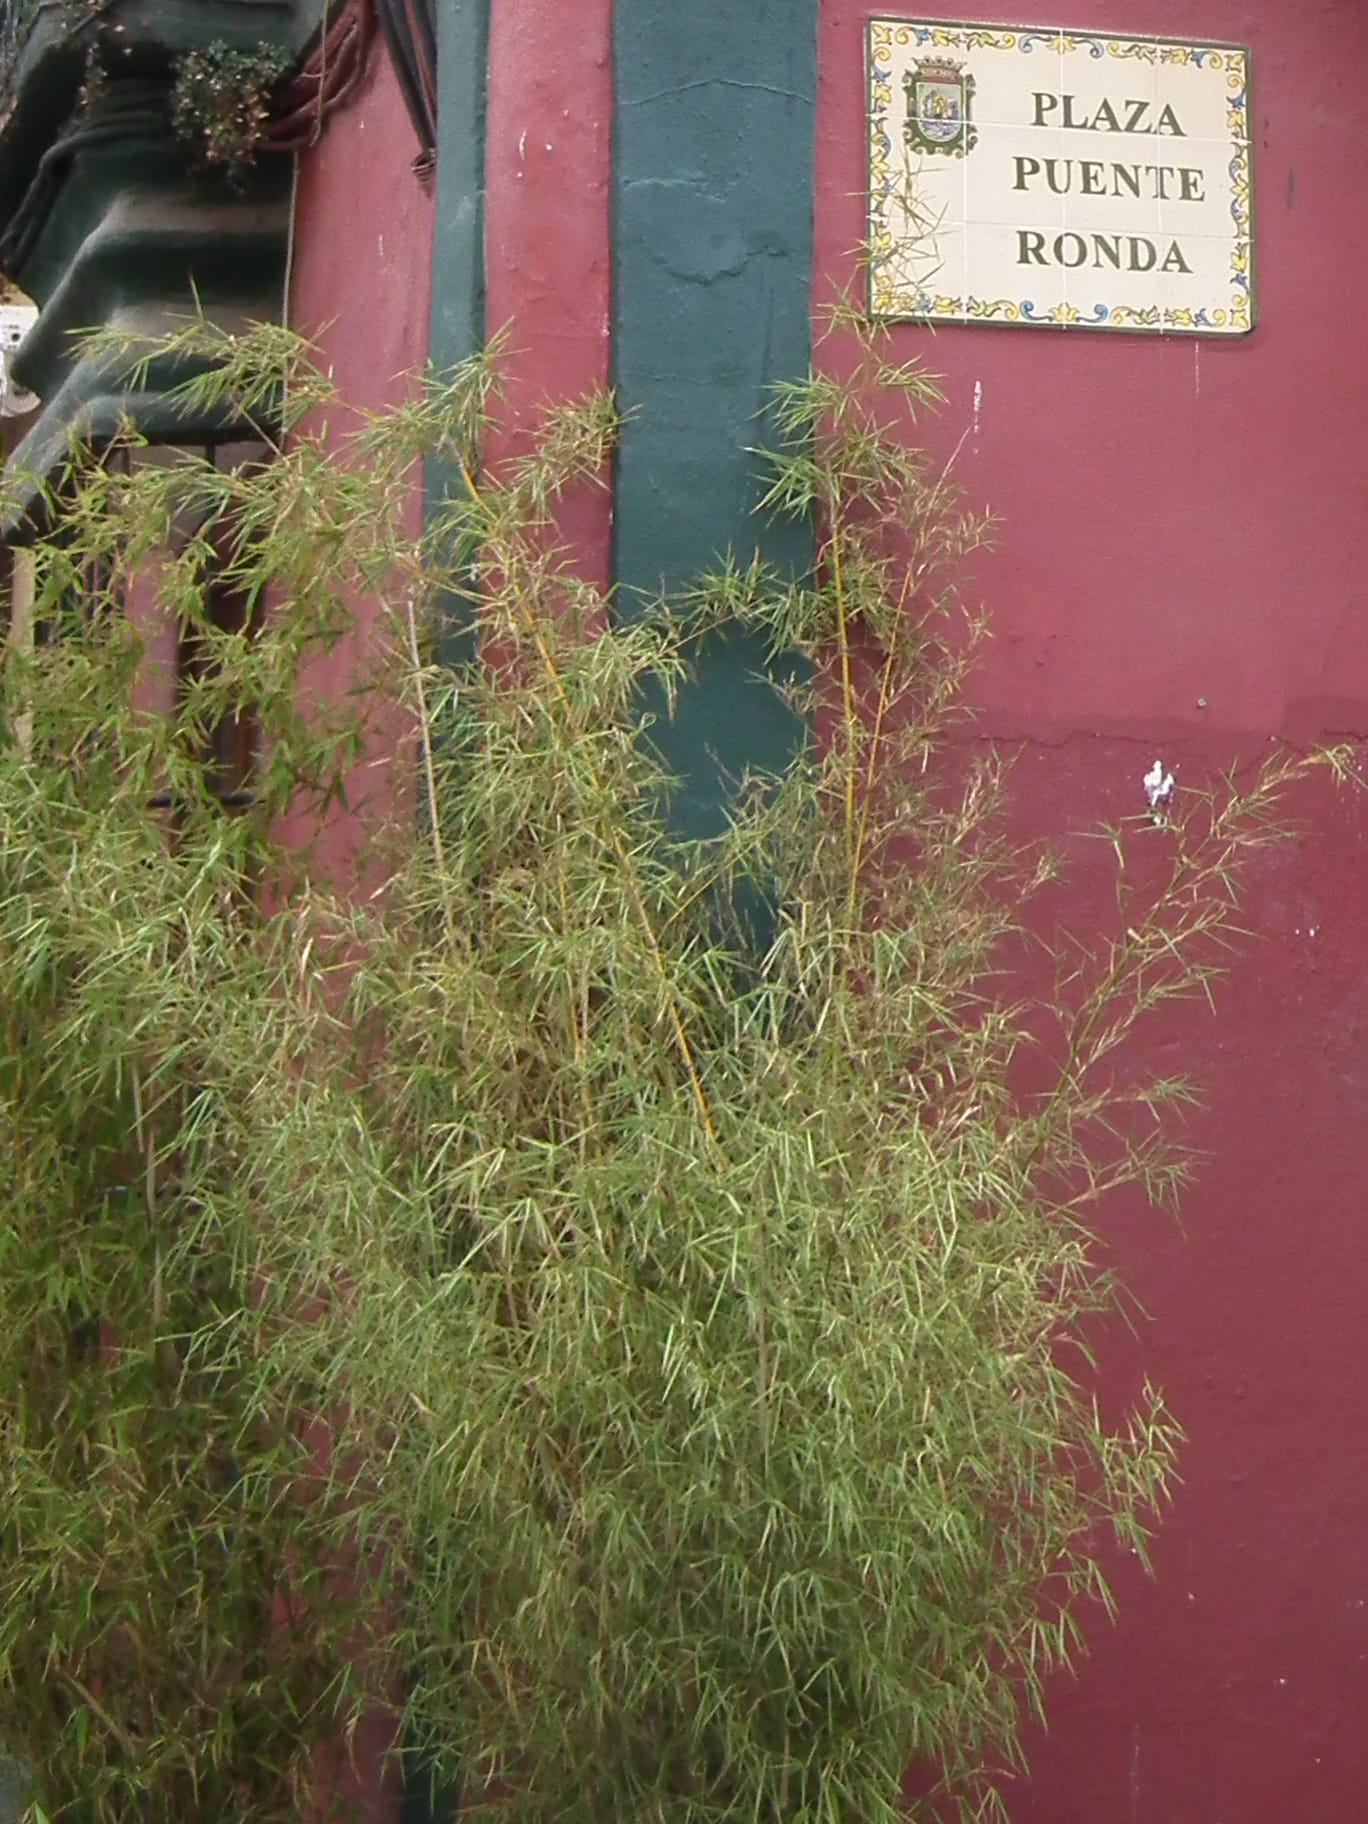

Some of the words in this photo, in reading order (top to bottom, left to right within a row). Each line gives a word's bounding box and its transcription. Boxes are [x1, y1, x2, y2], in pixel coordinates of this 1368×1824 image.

[1031, 92, 1187, 136] PLAZA
[1012, 156, 1205, 202] PUENTE
[1016, 230, 1193, 273] RONDA
